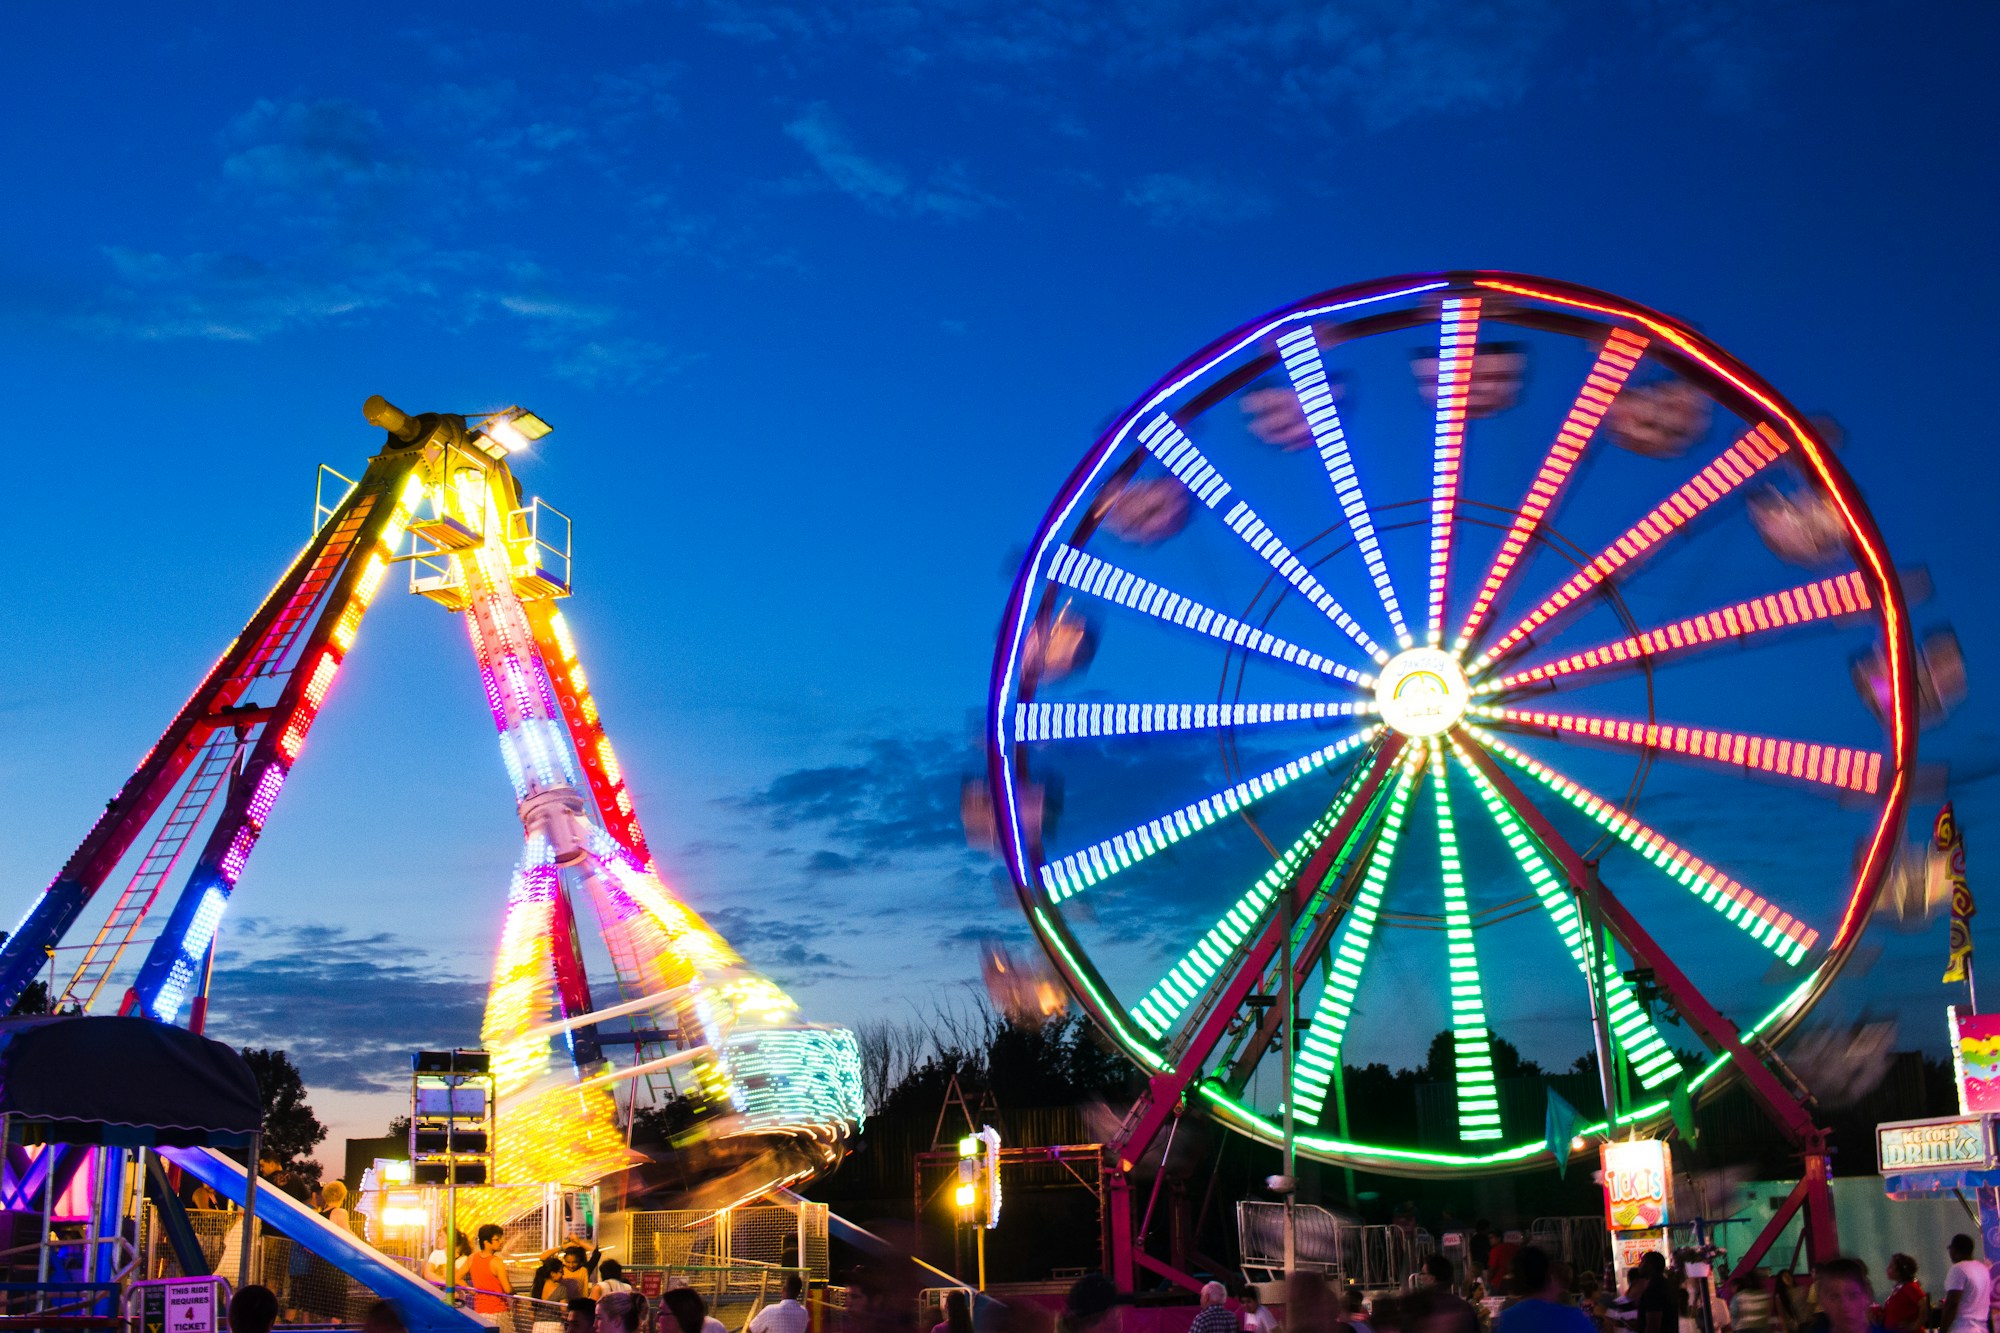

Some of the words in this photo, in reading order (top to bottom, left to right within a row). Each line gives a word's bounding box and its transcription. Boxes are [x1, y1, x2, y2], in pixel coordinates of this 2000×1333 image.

[1902, 1131, 1922, 1144] ICE
[1925, 1128, 1959, 1142] COLD
[1887, 1137, 1978, 1165] DRINKS
[1606, 1168, 1662, 1200] TICKETS
[171, 1287, 189, 1295] THIS
[190, 1286, 208, 1294] RIDE
[170, 1296, 209, 1305] REQUIRES
[184, 1306, 194, 1321] 4
[174, 1322, 206, 1331] TICKET
